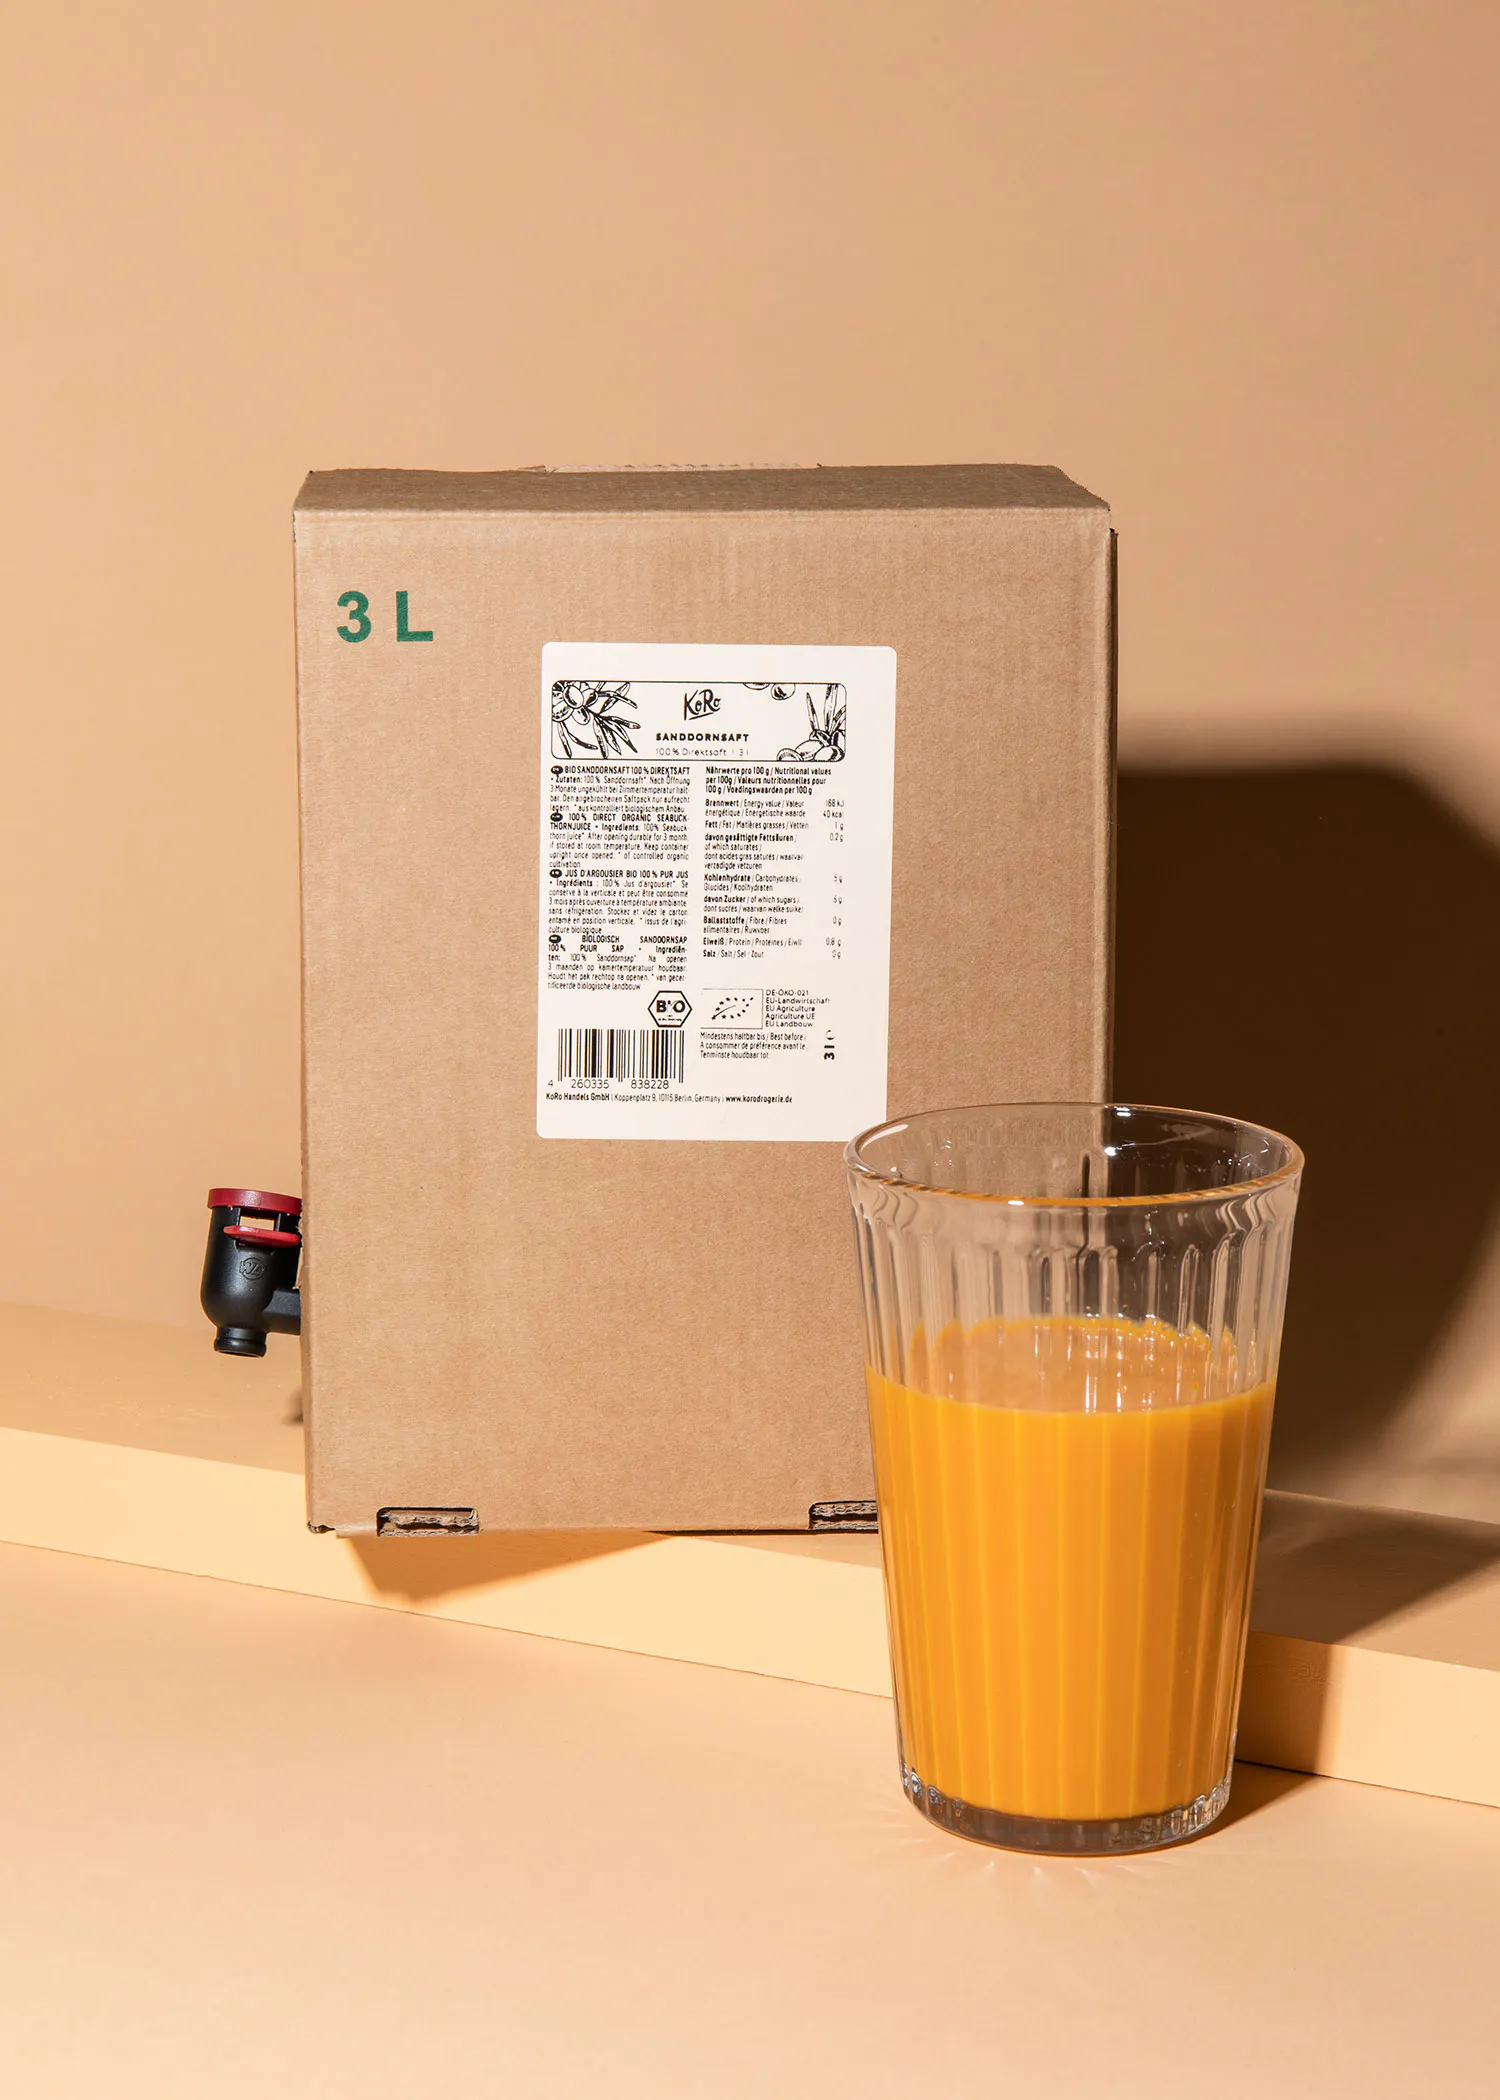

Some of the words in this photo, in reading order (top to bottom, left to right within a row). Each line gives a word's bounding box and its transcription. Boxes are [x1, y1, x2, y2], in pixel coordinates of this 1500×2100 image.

[335, 591, 373, 642] 3
[396, 591, 434, 642] L
[683, 689, 722, 720] KoRo
[655, 733, 749, 741] SANDDORNSAFT
[577, 766, 630, 774] SANDDORNSAFT
[741, 768, 752, 776] pro
[774, 767, 810, 775] Nutritional
[619, 786, 675, 794] Zimmertemperatur
[705, 785, 717, 793] 100
[727, 786, 783, 795] Voedingswaarden
[784, 787, 795, 795] per
[796, 786, 807, 794] 100
[743, 799, 764, 808] Energy
[763, 822, 786, 830] grasses
[644, 843, 659, 851] Keep
[704, 874, 751, 883] Kohlenhydrate
[703, 895, 723, 903] davon
[580, 944, 598, 952] PUUR
[570, 1080, 610, 1089] 260335
[630, 1080, 670, 1089] 838228
[614, 1094, 651, 1102] Koppenplatz
[725, 1095, 793, 1104] www.korodrogerie.de
